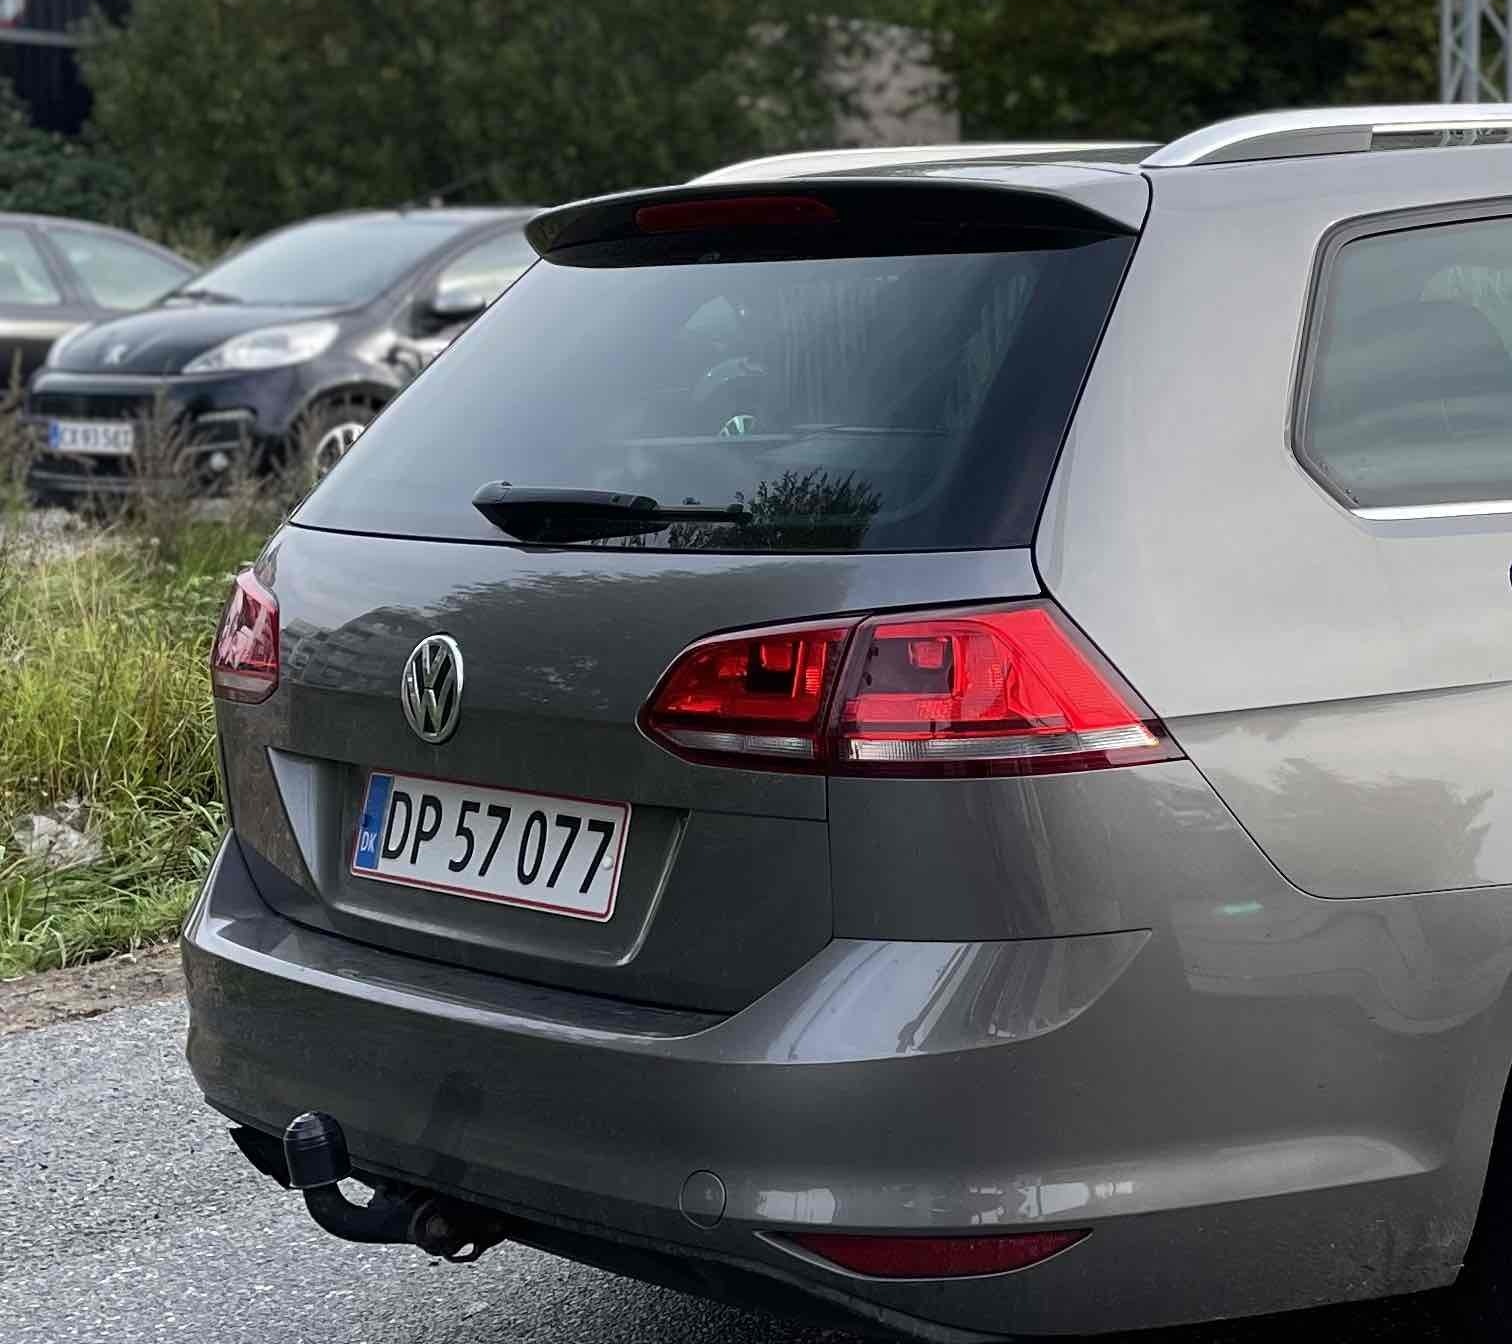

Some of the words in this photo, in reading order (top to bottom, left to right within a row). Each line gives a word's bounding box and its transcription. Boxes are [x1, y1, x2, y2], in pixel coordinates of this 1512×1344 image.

[359, 830, 378, 853] DK
[381, 791, 443, 864] DP
[448, 800, 511, 876] 57
[517, 810, 615, 893] 077
